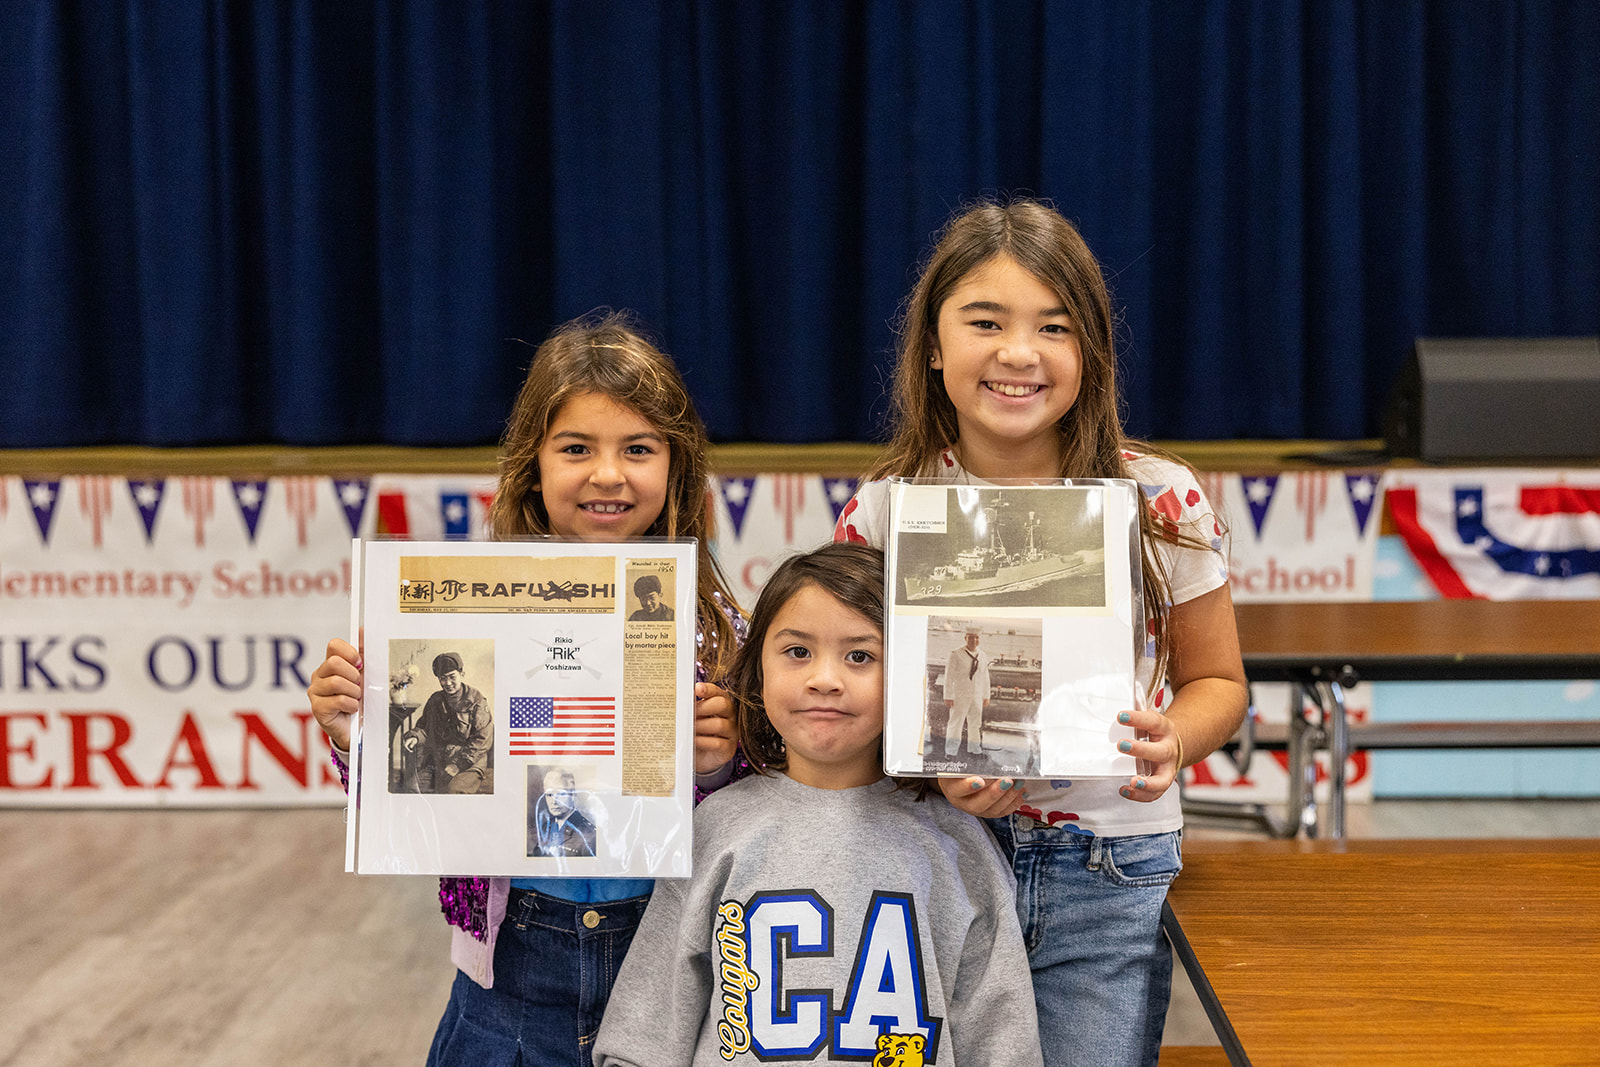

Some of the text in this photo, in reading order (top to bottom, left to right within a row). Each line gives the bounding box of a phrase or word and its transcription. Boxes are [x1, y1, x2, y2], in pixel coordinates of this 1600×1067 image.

[0, 559, 352, 609] ementary School
[471, 582, 545, 598] RAFU
[572, 583, 615, 598] SHI
[546, 647, 581, 660] “Rik”
[625, 641, 634, 649] by
[644, 632, 658, 640] boy
[0, 636, 314, 693] KS OUR
[0, 709, 346, 793] ERAN
[717, 899, 761, 1061] Cougars
[743, 888, 944, 1066] CA
